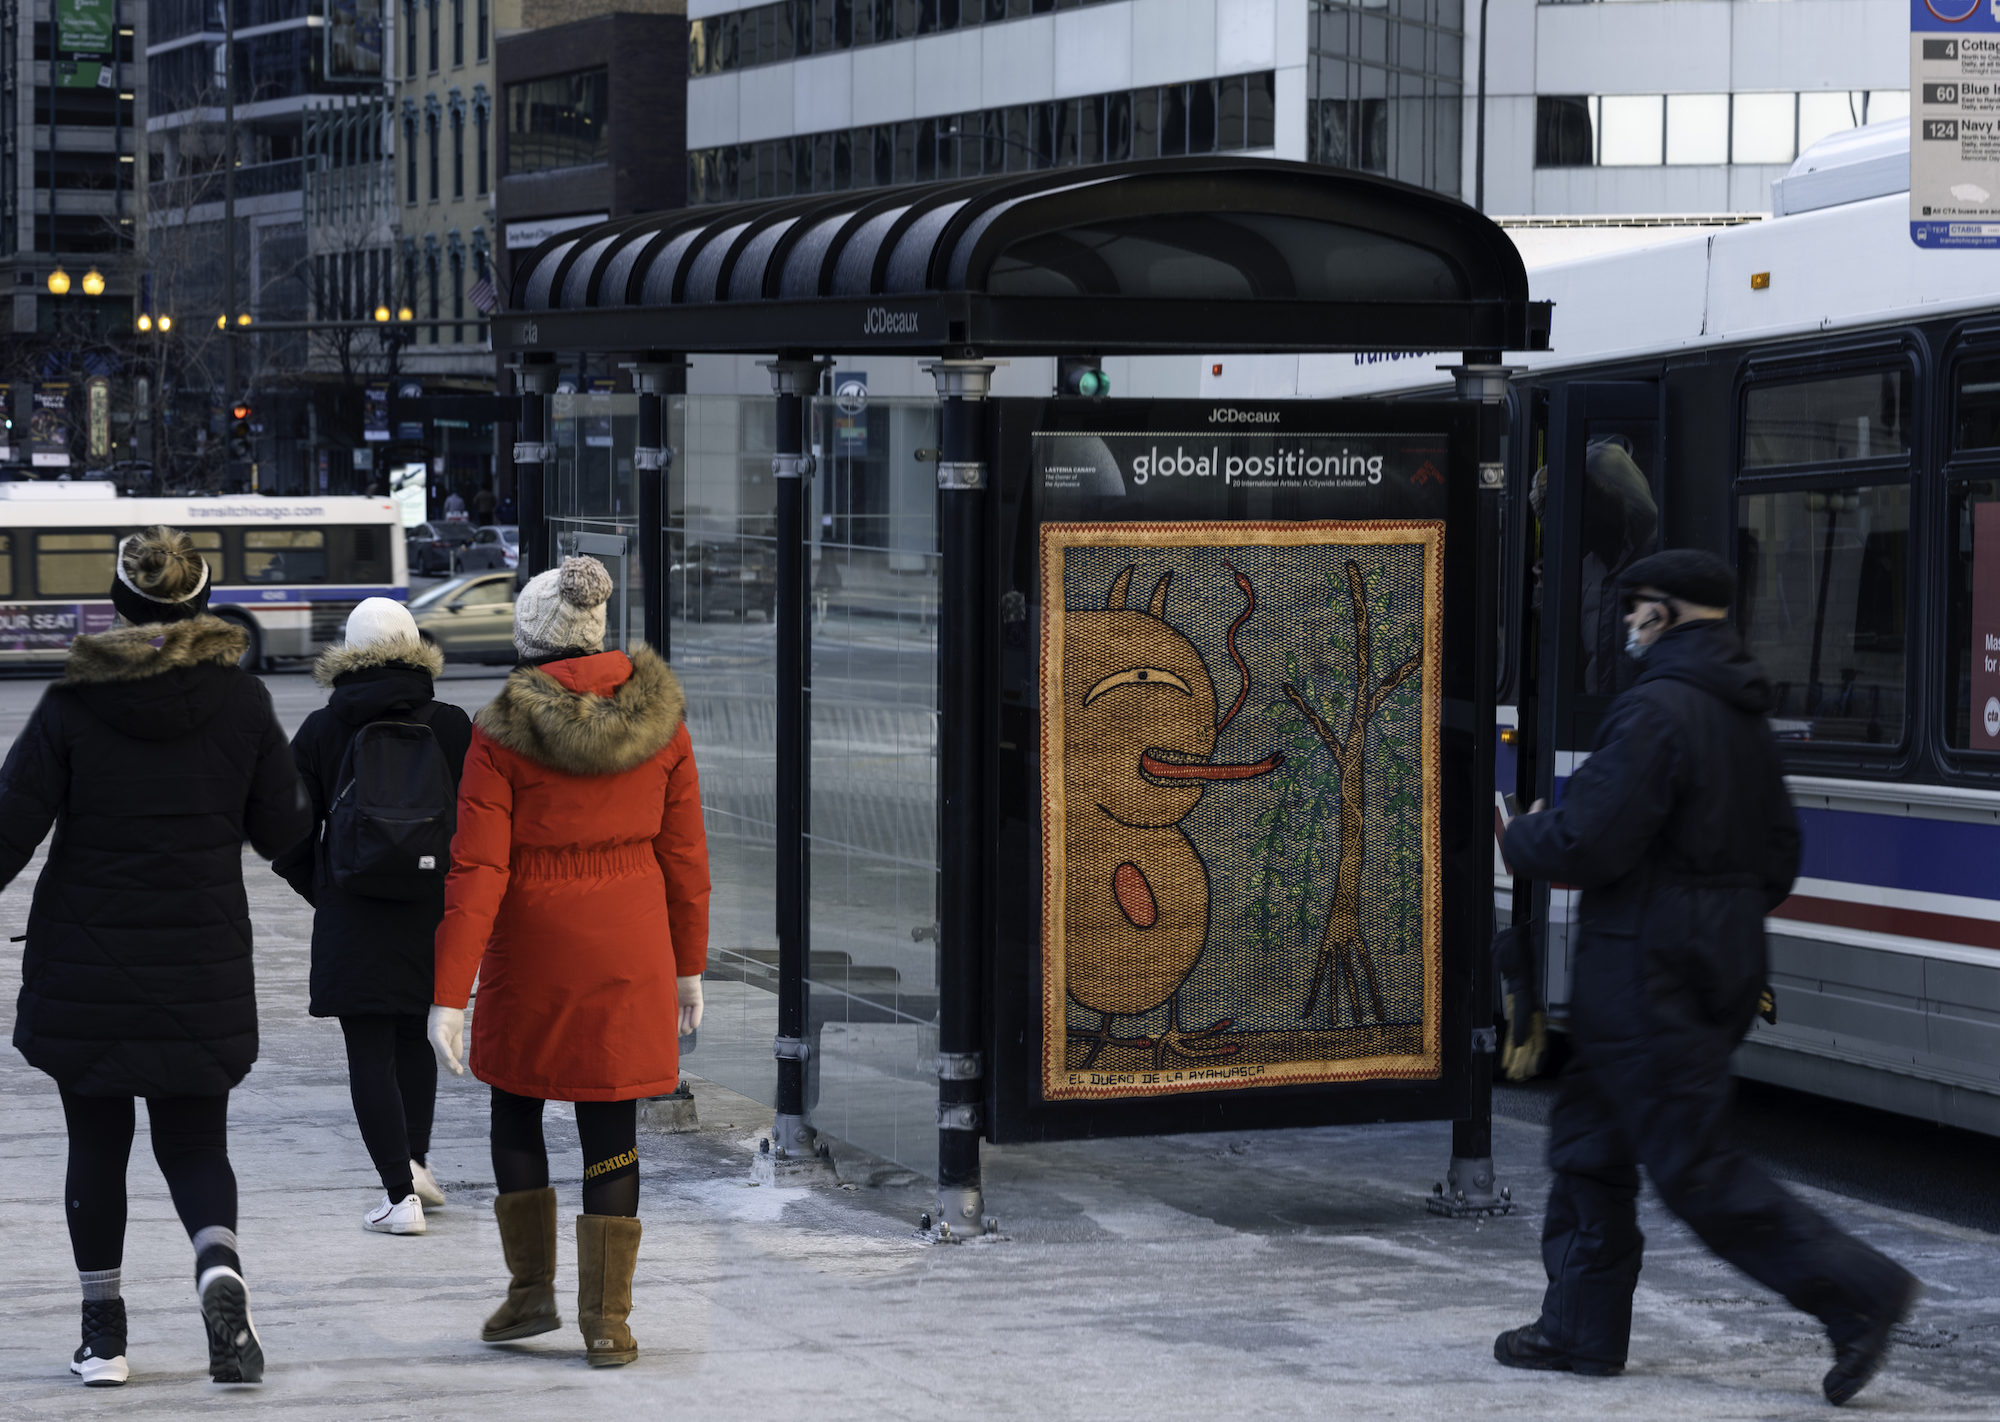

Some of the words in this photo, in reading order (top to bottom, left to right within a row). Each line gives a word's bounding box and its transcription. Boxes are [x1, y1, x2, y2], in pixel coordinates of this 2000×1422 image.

[1945, 42, 1955, 57] 4
[1936, 86, 1955, 102] 60
[1962, 83, 1990, 95] Blue
[1929, 122, 1955, 138] 124
[1962, 119, 1993, 134] Navy
[1932, 226, 1948, 234] TEXT
[1951, 226, 1982, 234] CTABUS
[863, 306, 919, 334] JCDecaux
[523, 320, 538, 344] cta
[1208, 408, 1280, 423] JCDecaux
[1133, 446, 1218, 485] global
[1226, 448, 1384, 485] positioning
[1232, 480, 1240, 488] 20
[1241, 480, 1279, 488] International
[1303, 480, 1308, 488] A
[1309, 480, 1336, 489] Citywide
[1336, 480, 1366, 488] Exhibition
[188, 506, 325, 520] transitchicago.com
[32, 614, 76, 630] SEAT
[1984, 655, 1998, 672] for
[1987, 710, 1999, 722] cta
[1069, 1074, 1085, 1085] EL
[1142, 1074, 1160, 1084] DE
[1166, 1072, 1182, 1082] LA
[1189, 1066, 1264, 1080] AYAHUASCA
